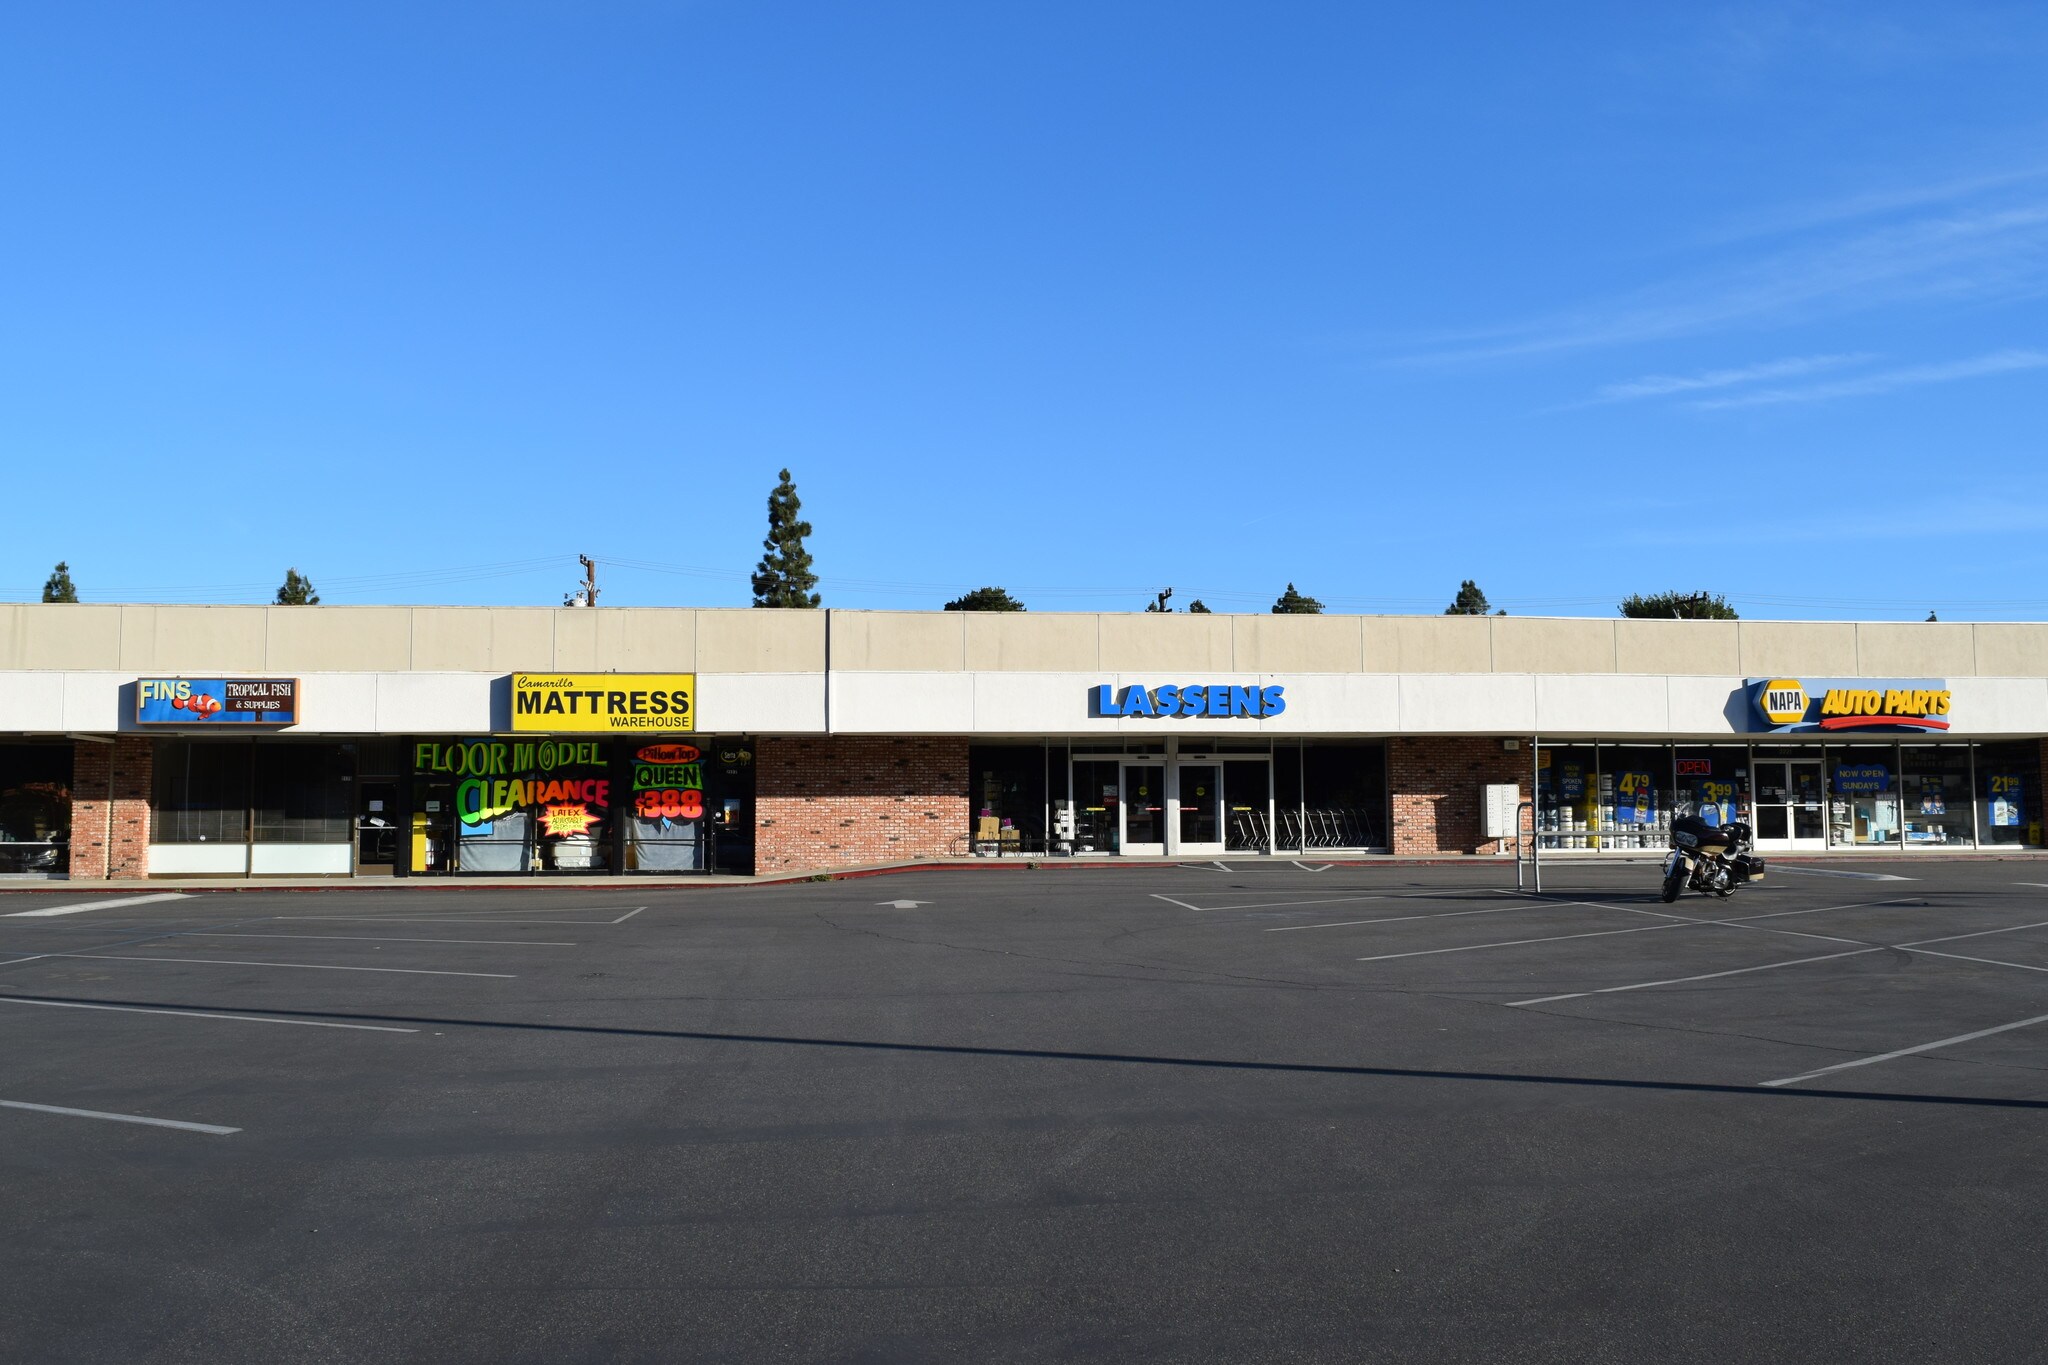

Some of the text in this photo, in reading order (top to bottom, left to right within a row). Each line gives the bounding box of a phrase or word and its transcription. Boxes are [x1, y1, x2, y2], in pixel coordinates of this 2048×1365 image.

[227, 683, 291, 696] TROPICAL FISH
[518, 676, 574, 688] Camarillo
[140, 681, 191, 709] FINS
[244, 700, 280, 709] SUPPLIES
[517, 691, 689, 715] MATTRESS
[1100, 684, 1286, 716] LASSENS
[1769, 691, 1802, 711] NAPA
[1821, 689, 1951, 715] AUTO PARTS
[610, 716, 689, 728] WAREHOUSE
[415, 740, 608, 777] FLOOR MODEL
[643, 747, 695, 760] Pillow Top
[637, 766, 697, 786] QUEEN
[1677, 761, 1709, 774] OPEN
[1619, 772, 1649, 796] 479
[1703, 781, 1732, 803] 399
[1842, 782, 1879, 790] SUNDAYS
[1991, 776, 2019, 792] 2199
[456, 778, 610, 825] CLEARANCE
[634, 789, 703, 818] $388
[552, 809, 580, 817] LATEX
